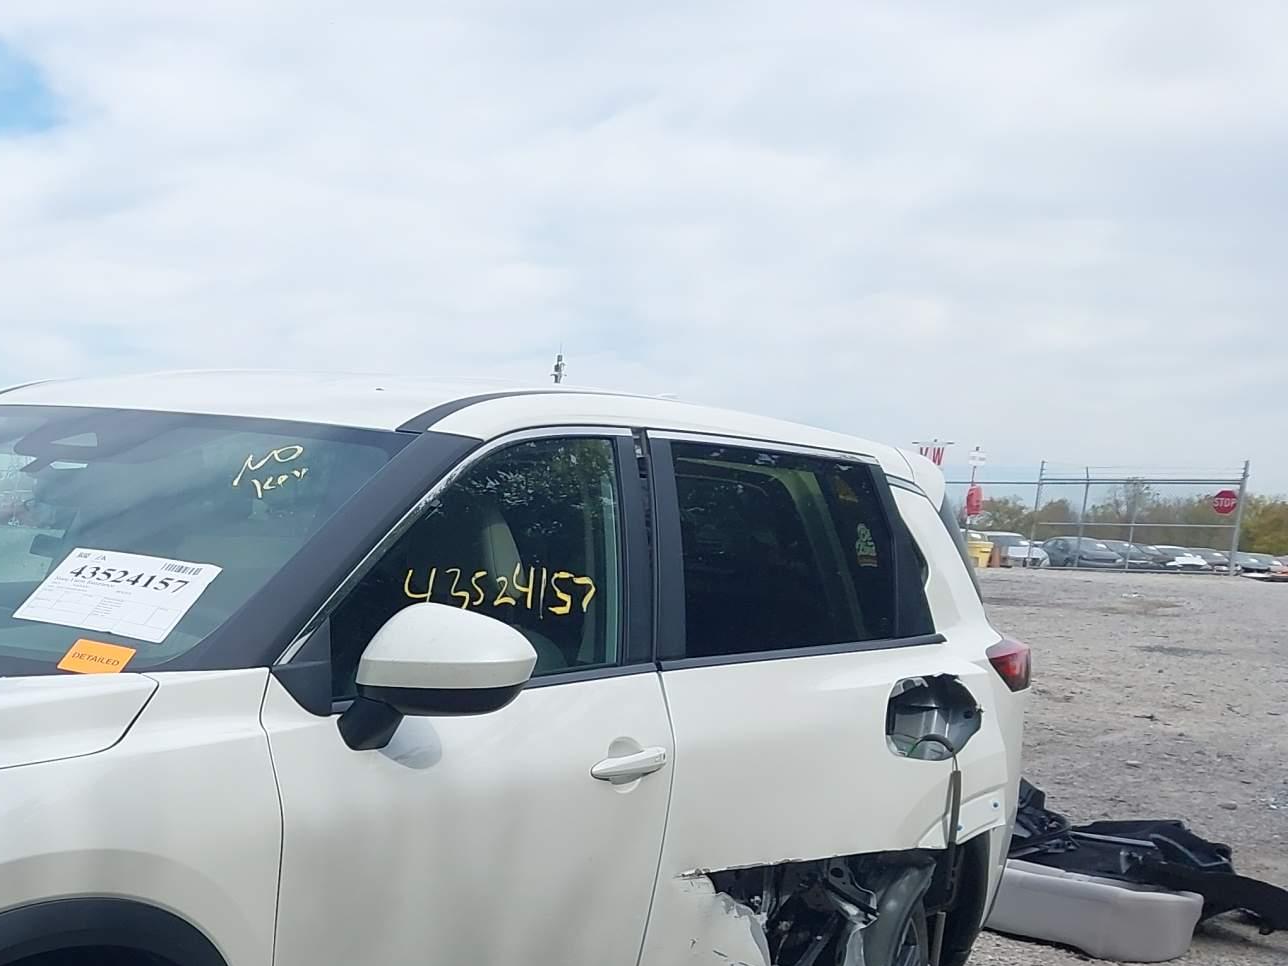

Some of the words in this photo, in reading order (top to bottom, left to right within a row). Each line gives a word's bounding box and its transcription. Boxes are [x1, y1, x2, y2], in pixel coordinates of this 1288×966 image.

[1214, 497, 1237, 507] STOP
[70, 564, 190, 594] 43524157
[404, 562, 596, 620] 43524157
[72, 652, 120, 666] DETAILED
